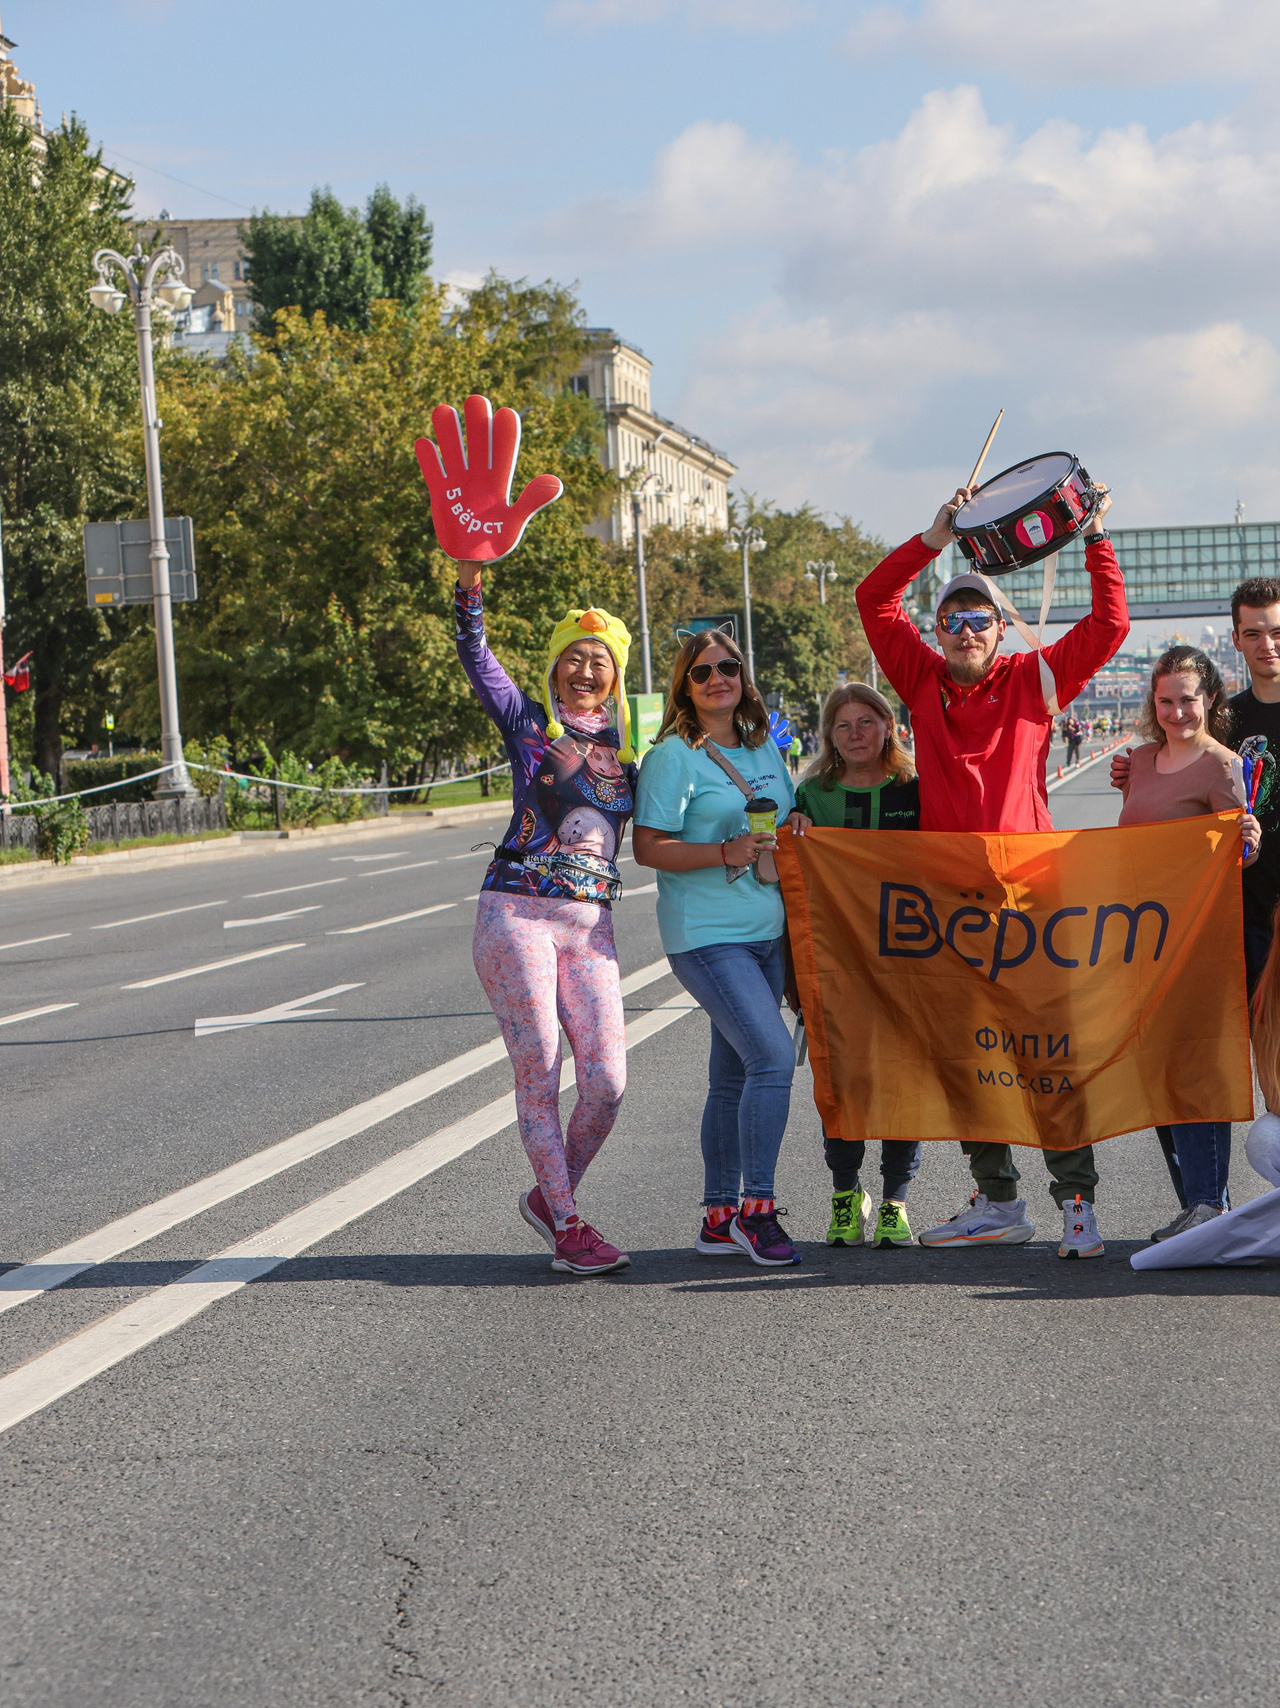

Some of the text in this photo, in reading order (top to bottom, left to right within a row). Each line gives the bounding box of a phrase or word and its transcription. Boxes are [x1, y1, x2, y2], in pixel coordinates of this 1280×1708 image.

[446, 487, 504, 534] 5 вёрст
[975, 1026, 1070, 1059] ФИЛИ
[977, 1068, 1074, 1095] МОСКВА
